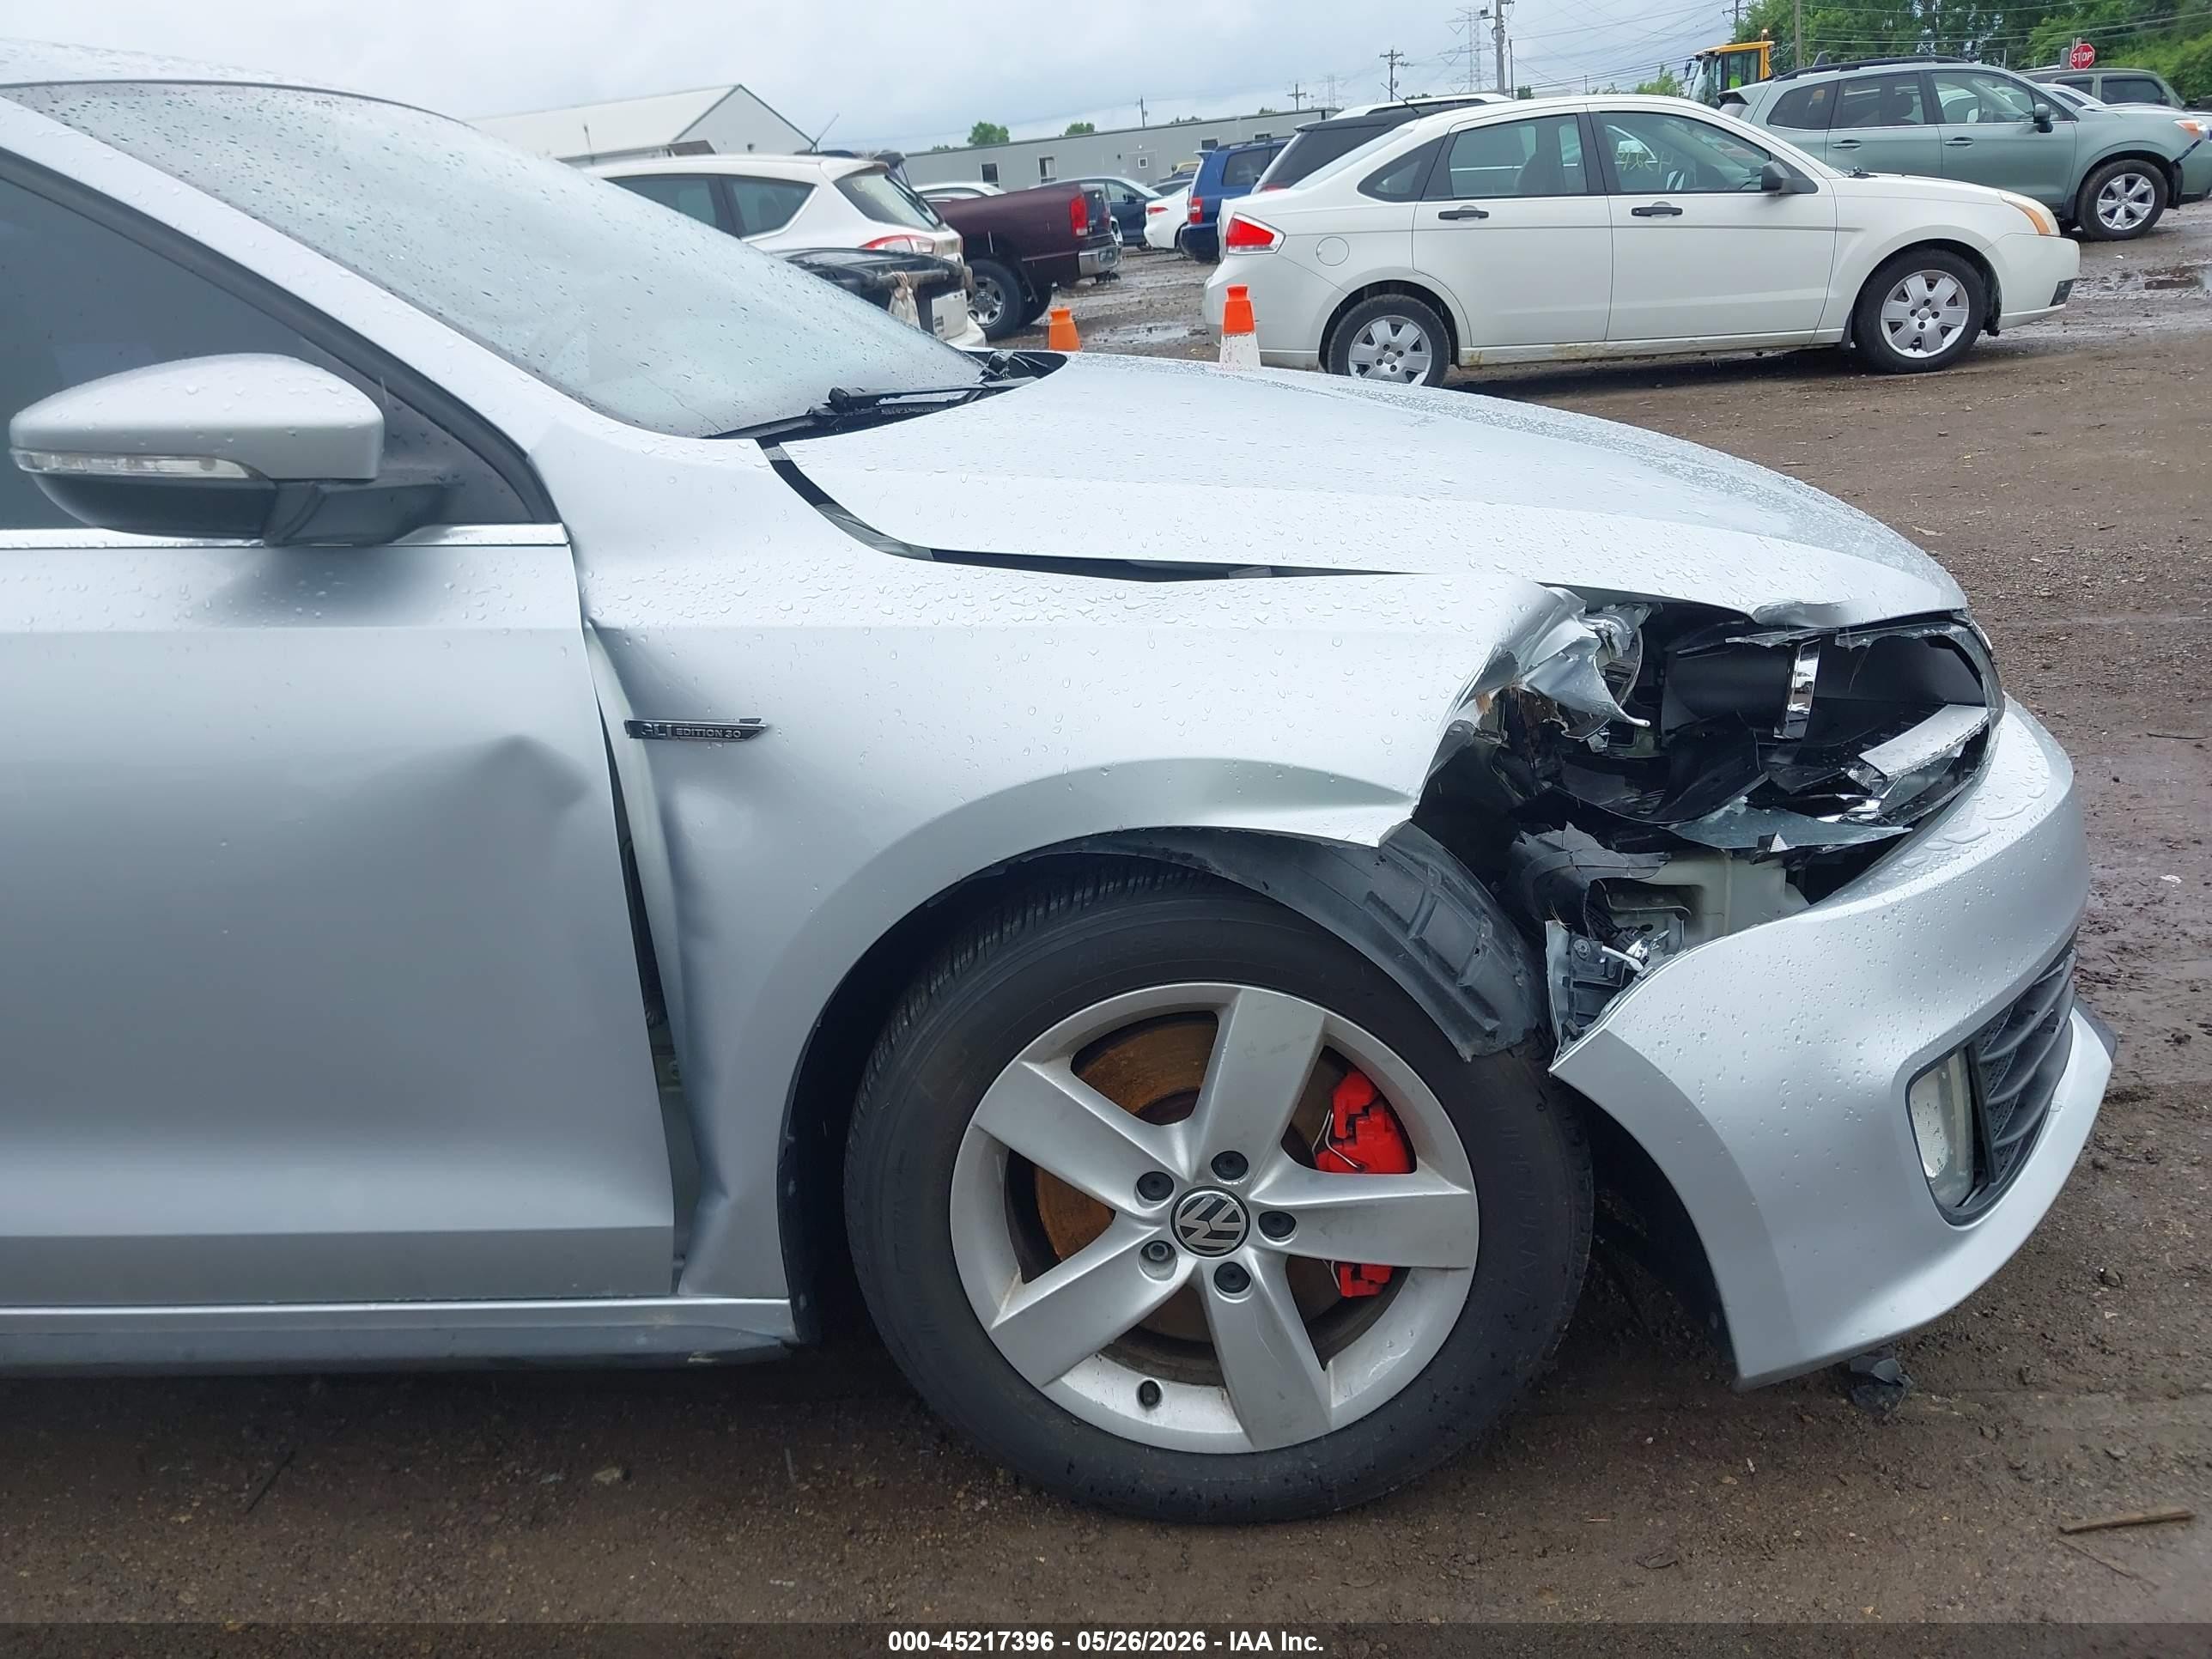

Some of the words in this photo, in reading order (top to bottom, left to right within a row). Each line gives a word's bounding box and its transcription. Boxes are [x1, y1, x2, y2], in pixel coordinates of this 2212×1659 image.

[2071, 52, 2094, 63] STOP
[676, 727, 724, 738] EDITION
[724, 730, 742, 738] 30
